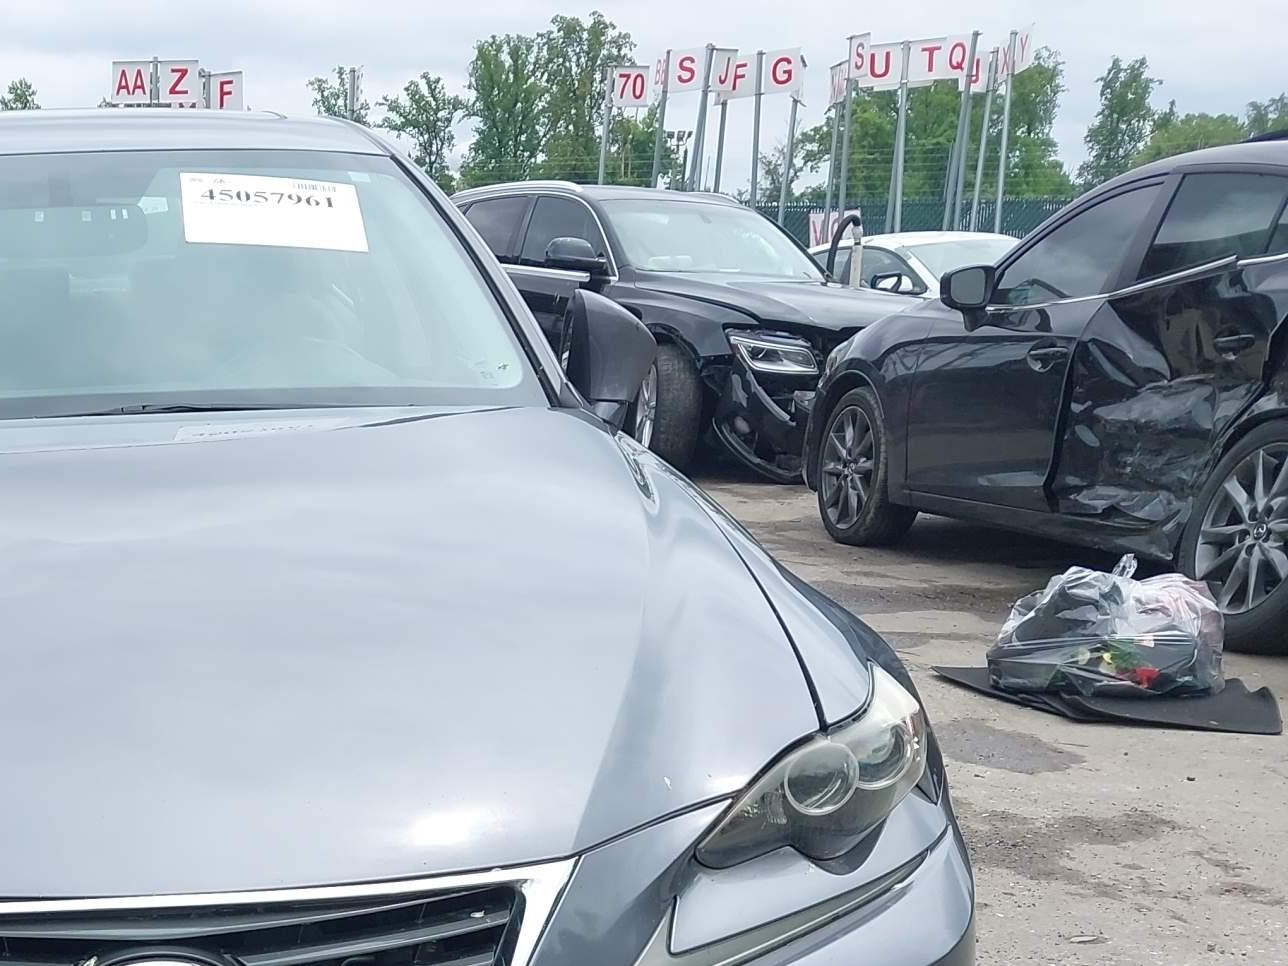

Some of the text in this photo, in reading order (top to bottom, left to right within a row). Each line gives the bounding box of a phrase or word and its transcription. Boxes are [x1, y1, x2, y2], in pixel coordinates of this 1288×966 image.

[855, 42, 865, 70] S
[921, 45, 942, 73] T
[948, 42, 966, 71] Q
[1020, 34, 1029, 63] Y
[677, 56, 696, 84] S
[718, 57, 731, 85] J
[732, 62, 748, 91] F
[771, 56, 793, 85] G
[869, 51, 890, 78] U
[116, 69, 146, 96] AA
[169, 68, 189, 95] Z
[219, 79, 234, 109] F
[618, 73, 645, 100] 70
[200, 188, 334, 208] 45057961
